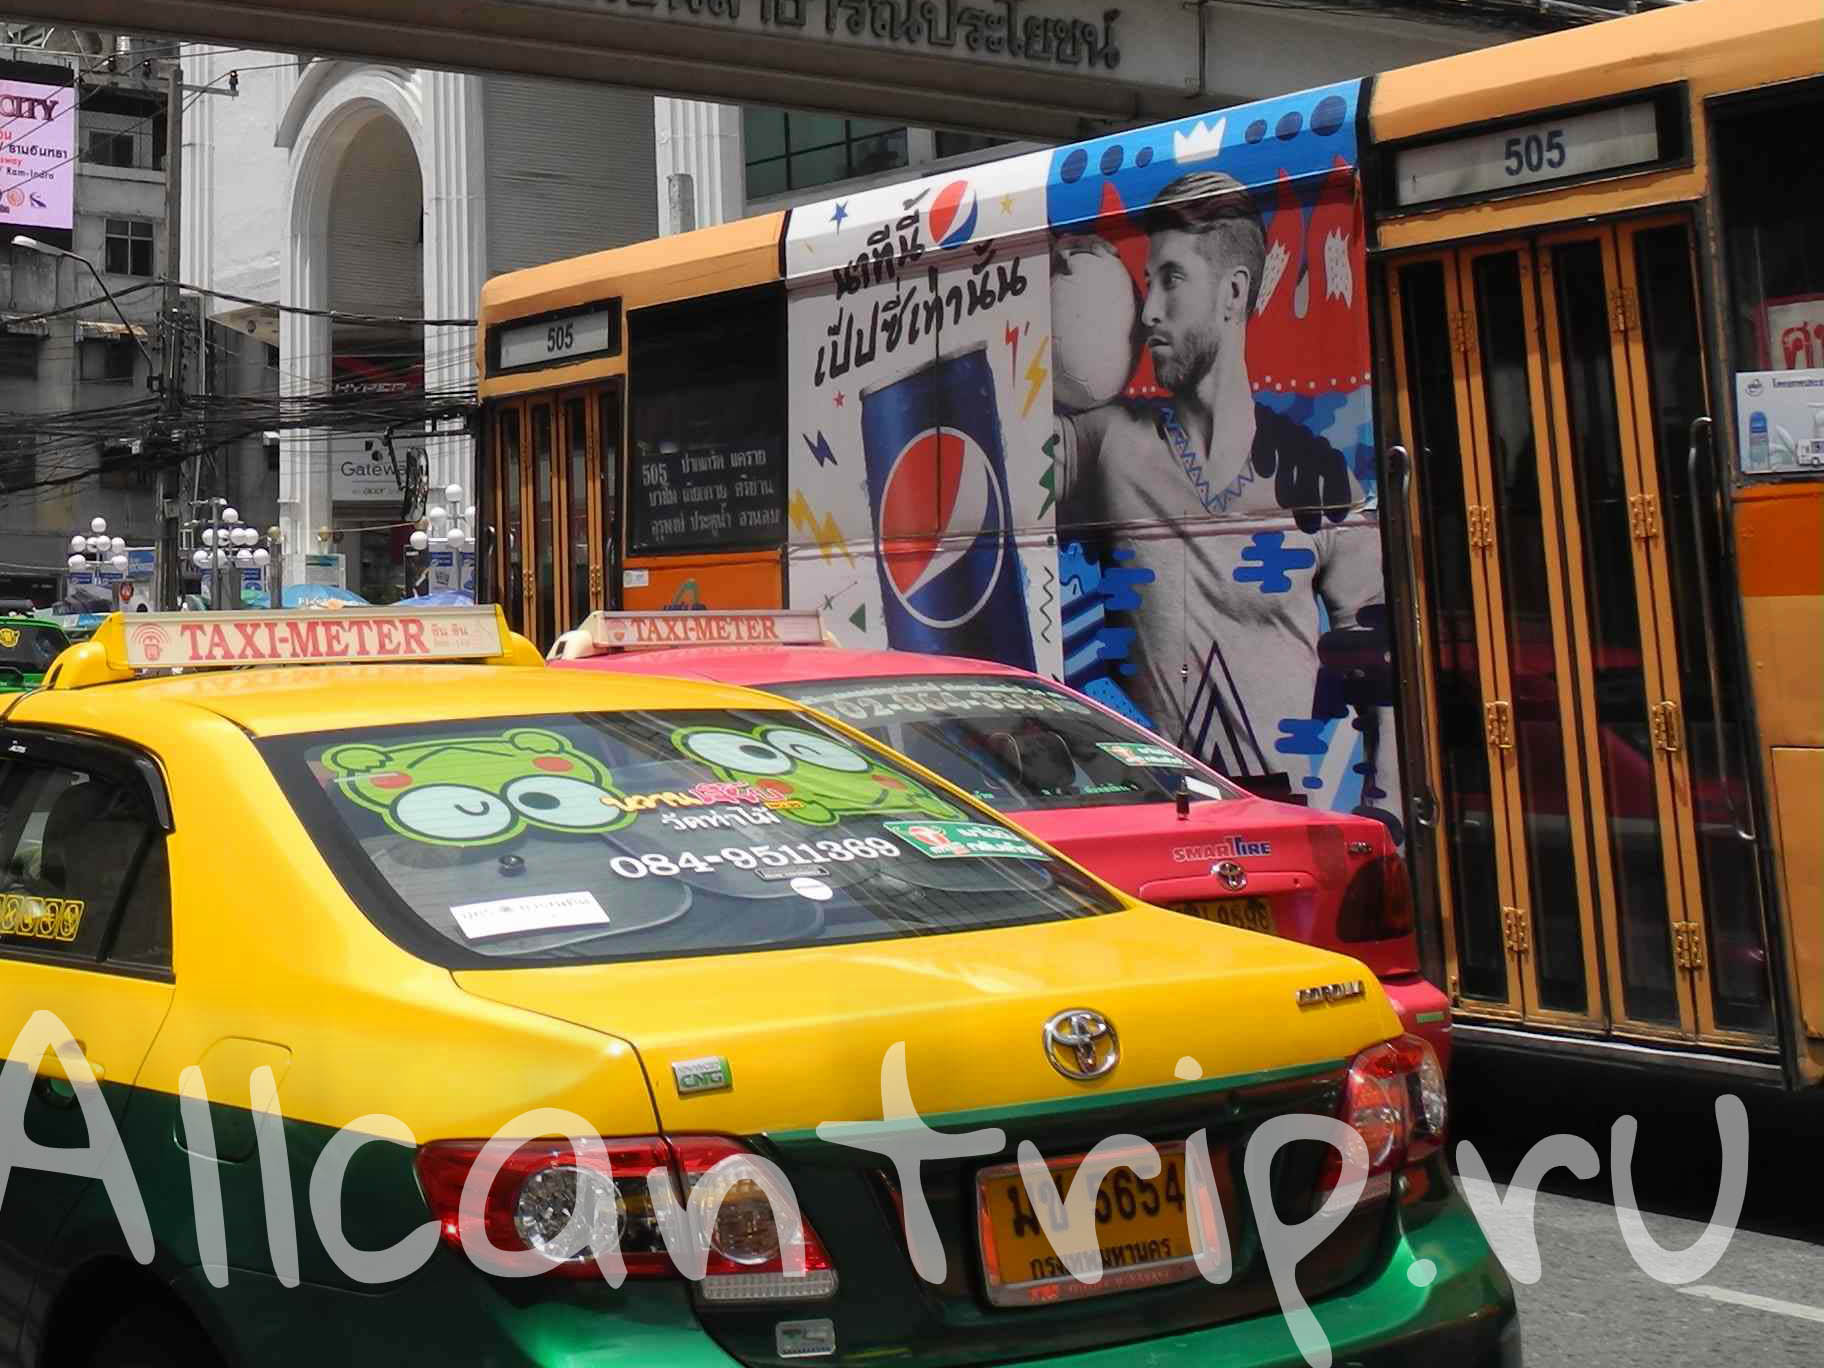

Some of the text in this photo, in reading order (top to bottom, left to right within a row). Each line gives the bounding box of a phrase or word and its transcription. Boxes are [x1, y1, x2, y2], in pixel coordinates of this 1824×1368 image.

[1504, 131, 1565, 176] 505
[547, 327, 573, 352] 505
[340, 461, 408, 477] Gatewa
[642, 463, 668, 487] 505
[180, 619, 430, 661] TAXI-METER
[629, 614, 775, 642] TAXI-METER
[662, 806, 781, 833] วัดท่าไม้
[609, 836, 901, 879] 084-9511369
